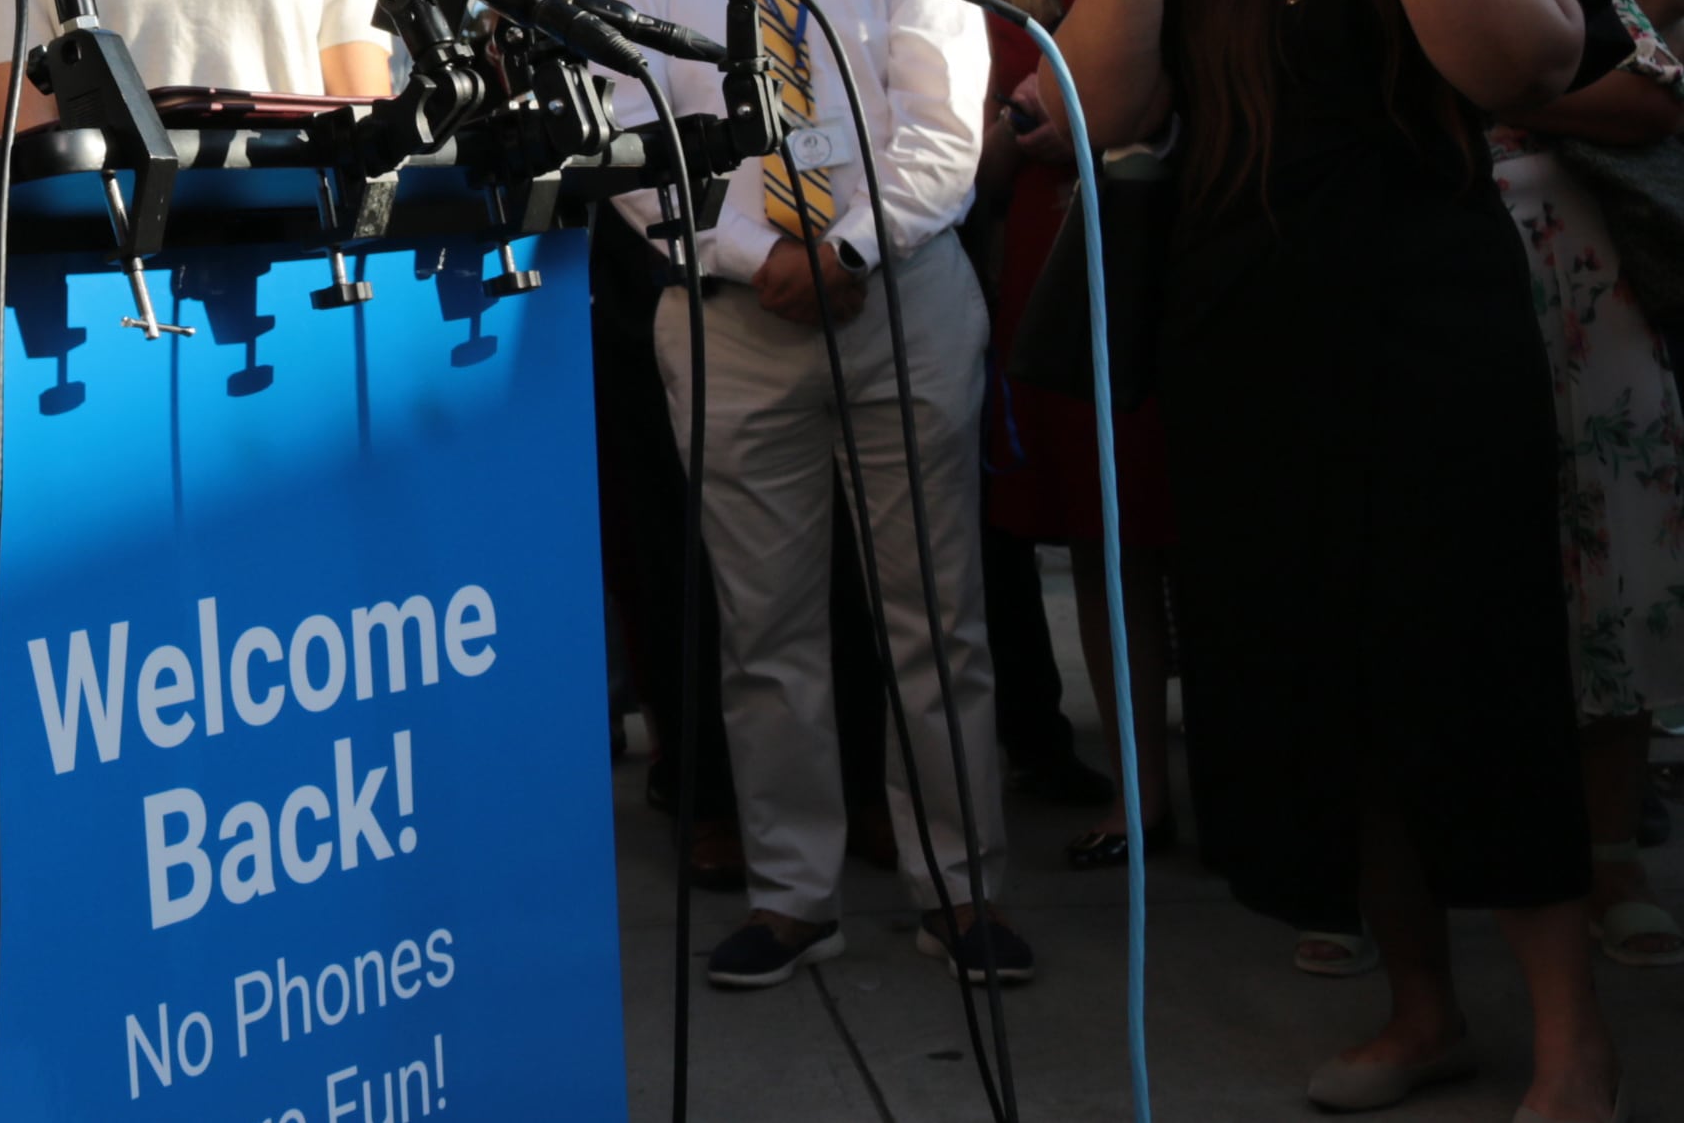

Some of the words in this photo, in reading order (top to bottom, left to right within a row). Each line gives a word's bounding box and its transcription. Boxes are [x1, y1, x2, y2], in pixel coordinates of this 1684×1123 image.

[27, 584, 498, 775] Welcome
[143, 729, 418, 930] Back!
[125, 1002, 214, 1100] No
[234, 928, 455, 1058] Phones
[326, 1033, 447, 1123] Fun!
